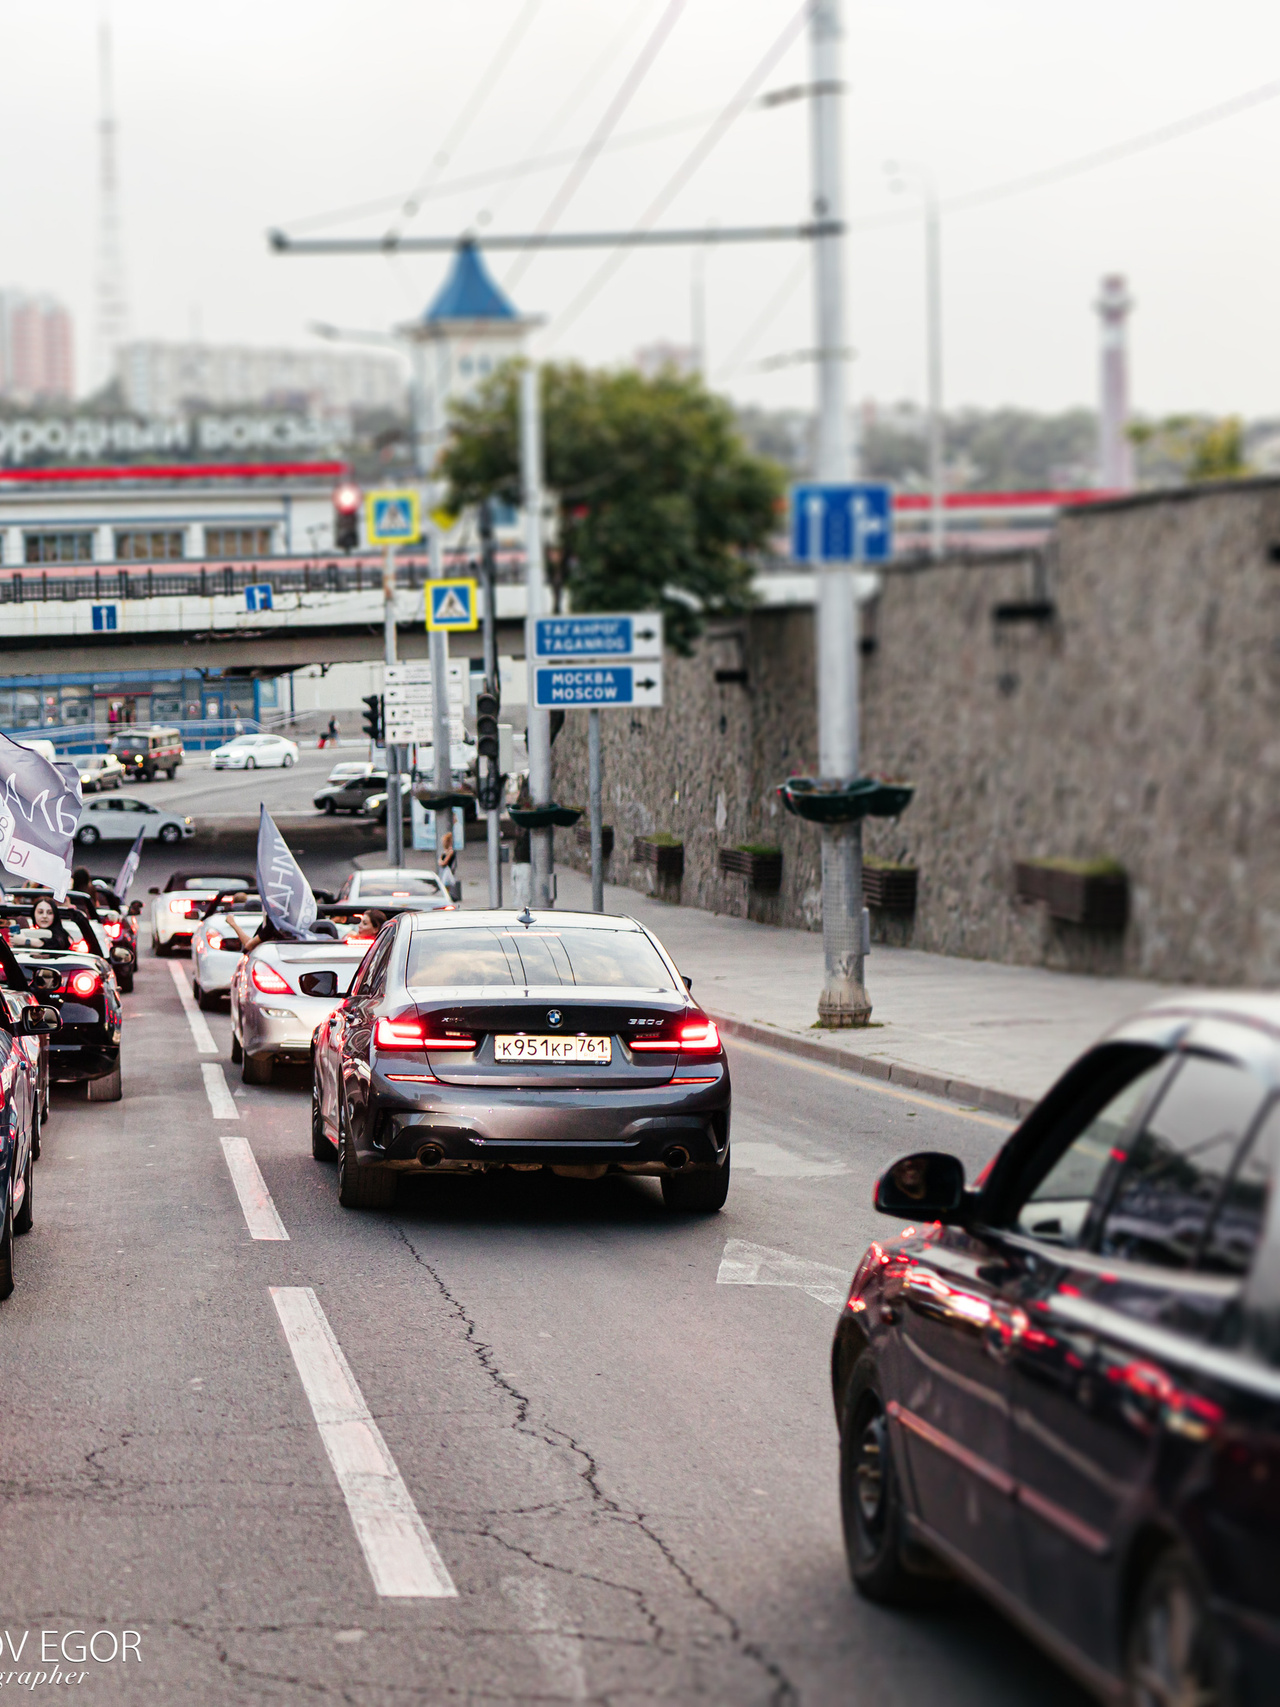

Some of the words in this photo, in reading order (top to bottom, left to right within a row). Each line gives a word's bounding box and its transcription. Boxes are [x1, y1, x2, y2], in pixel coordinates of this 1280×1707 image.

[543, 638, 626, 652] TAGANROG
[552, 672, 615, 686] МОСКВА
[552, 687, 618, 701] MOSCOW
[502, 1038, 574, 1057] К951КР
[578, 1038, 605, 1053] 761
